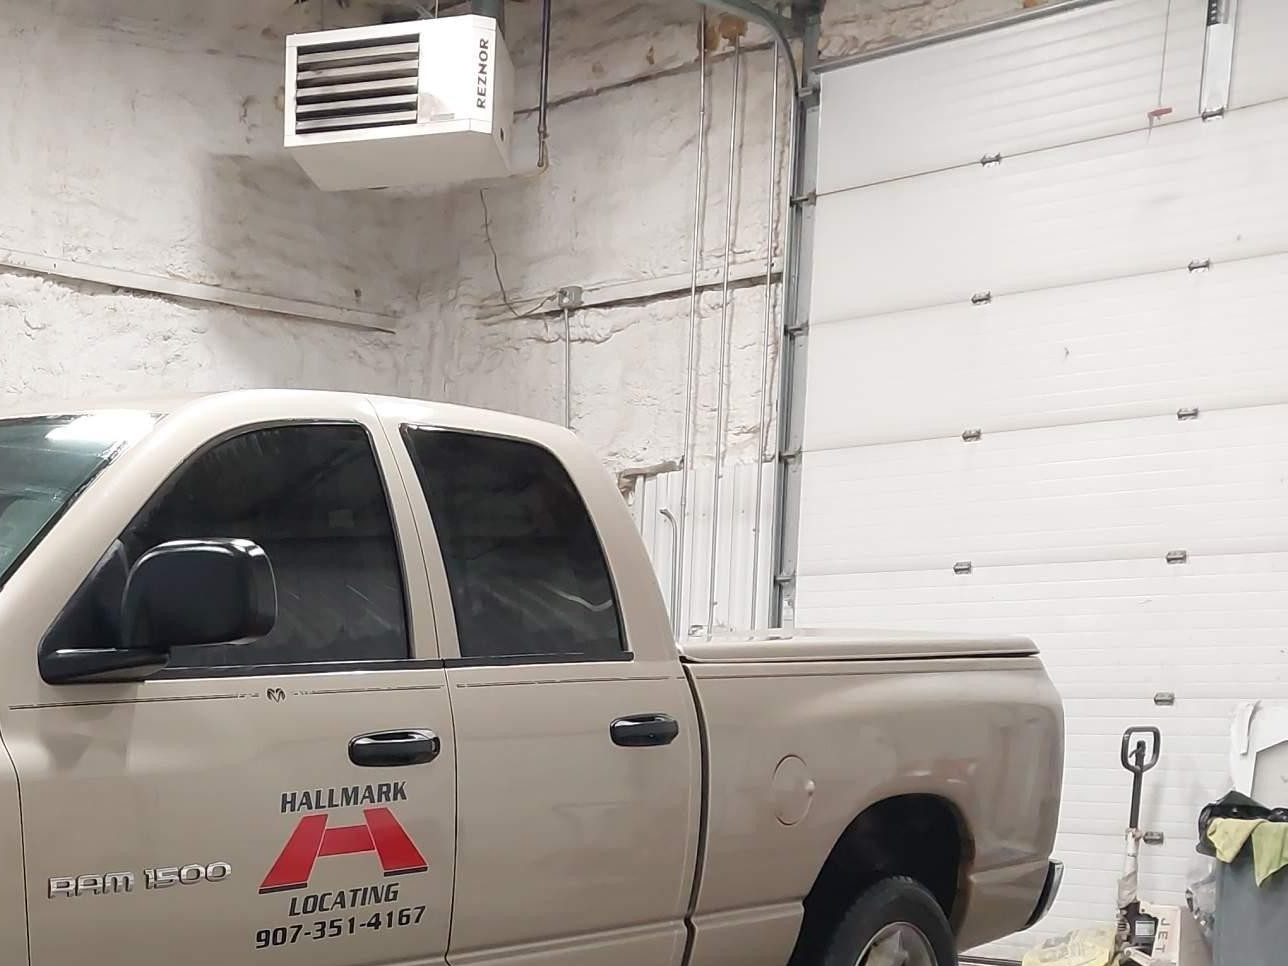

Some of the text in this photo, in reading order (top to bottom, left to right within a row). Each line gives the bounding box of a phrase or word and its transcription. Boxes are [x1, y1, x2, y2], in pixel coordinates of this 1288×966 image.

[476, 38, 489, 109] REZNOR
[280, 781, 408, 814] HALLMARK
[47, 861, 233, 900] RAM 1500
[288, 882, 400, 917] LOCATING
[255, 905, 426, 949] 907-351-4167
[1155, 918, 1170, 952] JET
